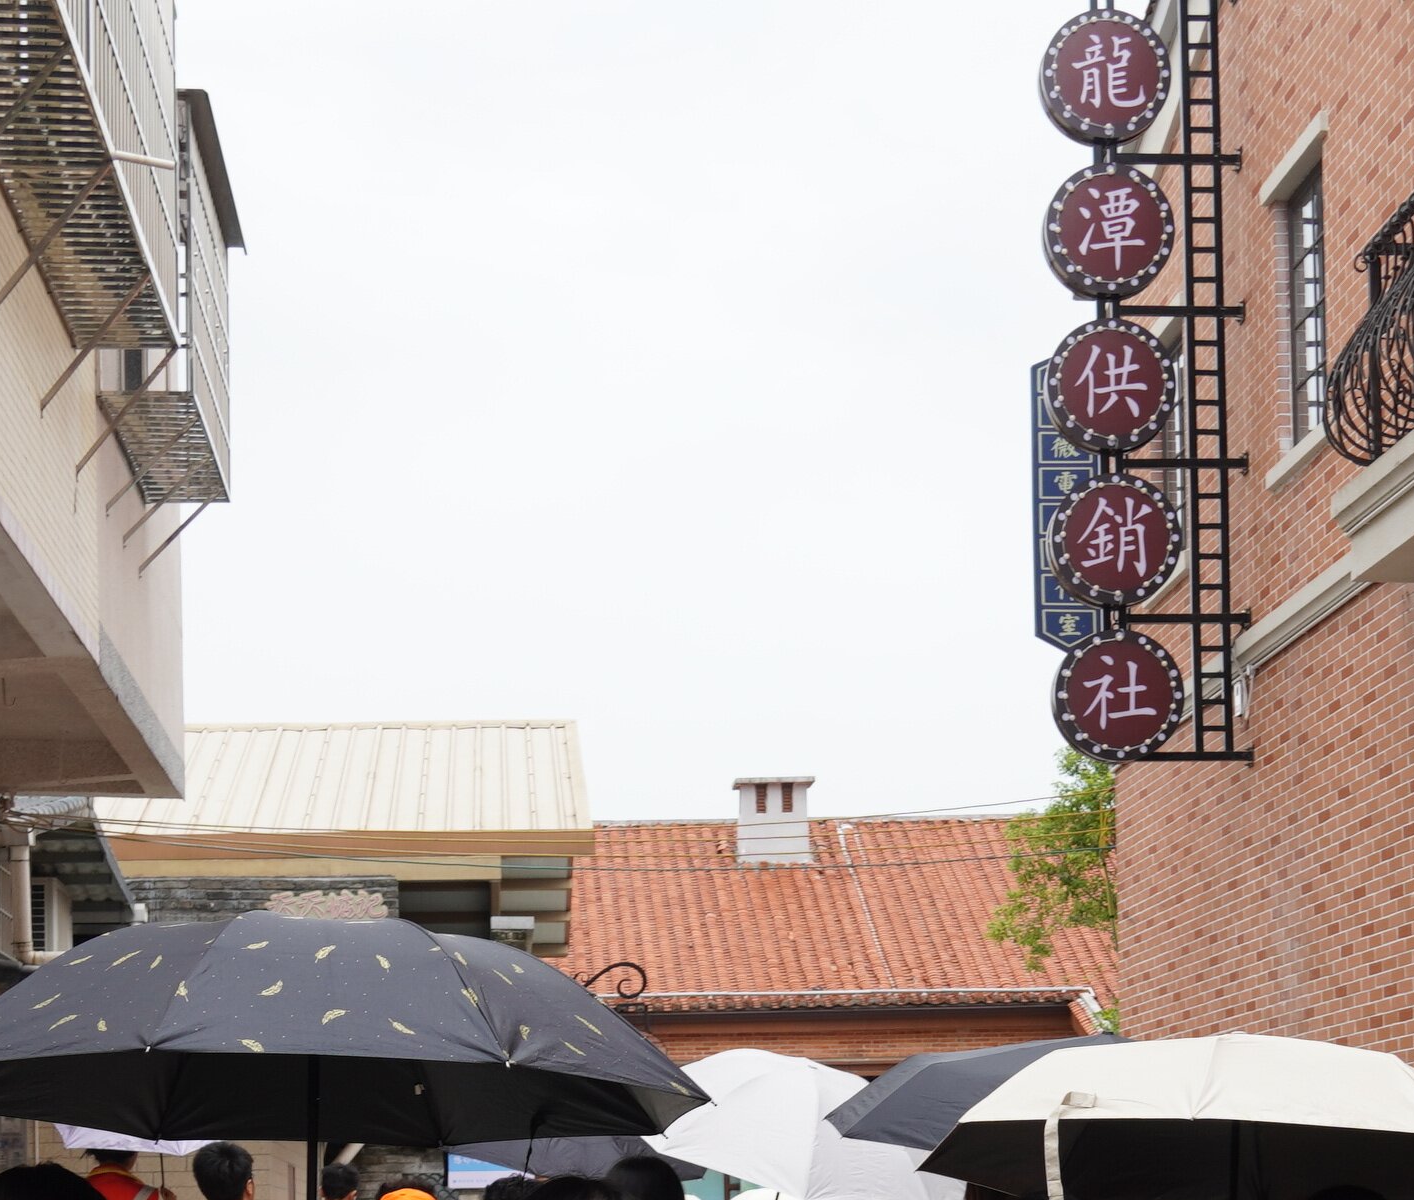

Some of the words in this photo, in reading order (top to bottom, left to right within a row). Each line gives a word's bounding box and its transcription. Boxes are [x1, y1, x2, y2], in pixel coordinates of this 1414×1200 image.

[1071, 34, 1157, 730] 龍潭供銷社
